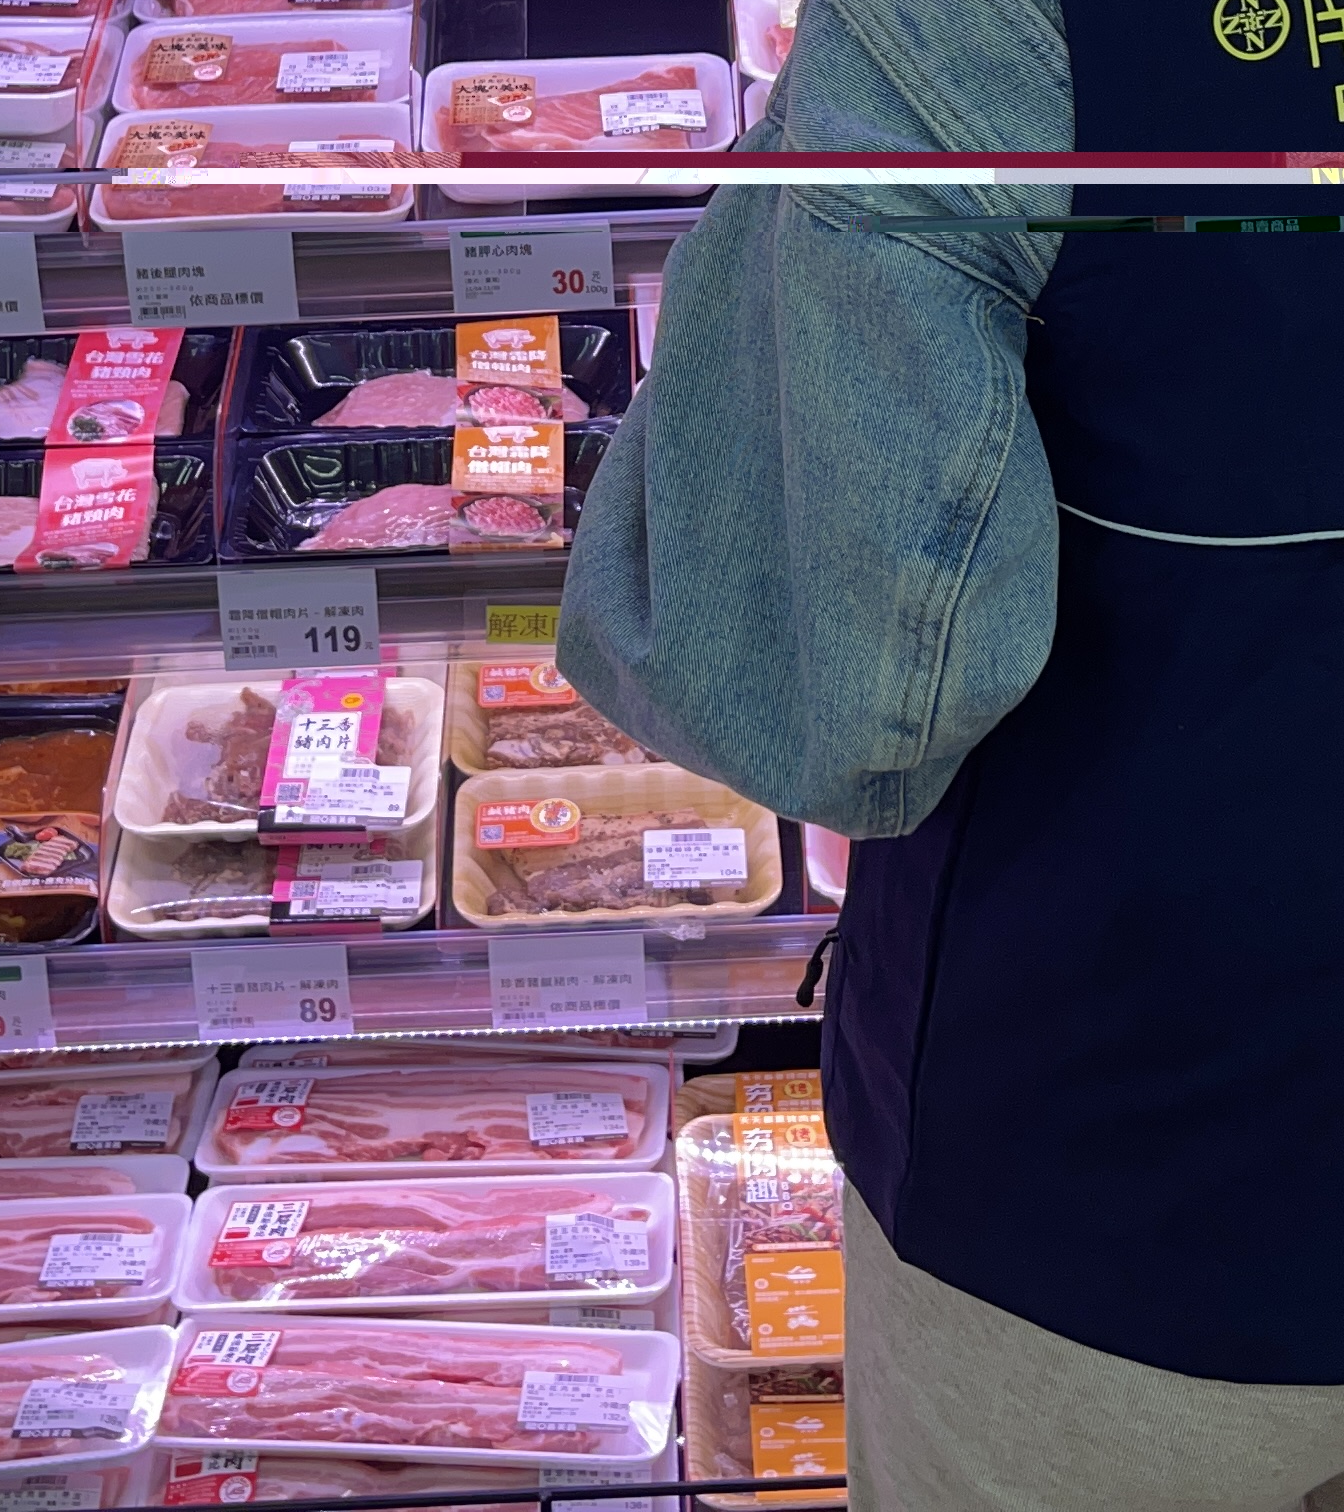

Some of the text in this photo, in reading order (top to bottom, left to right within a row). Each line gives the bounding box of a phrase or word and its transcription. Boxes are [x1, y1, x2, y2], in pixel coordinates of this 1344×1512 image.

[136, 266, 205, 281] 豬後腿肉塊
[552, 269, 584, 294] 30
[190, 291, 264, 307] 依商品標價
[85, 350, 164, 365] 台灣雪花
[470, 349, 547, 363] 台灣霜降
[467, 444, 551, 459] 台灣霜降
[53, 488, 137, 512] 台灣雪花
[324, 605, 364, 618] 解凍肉
[304, 624, 362, 654] 119
[298, 717, 354, 733] 十三香
[294, 735, 352, 750] 豬肉片
[299, 978, 339, 991] 解凍肉
[299, 997, 337, 1023] 89
[550, 999, 621, 1012] 依商品標價
[790, 1127, 812, 1144] 烤
